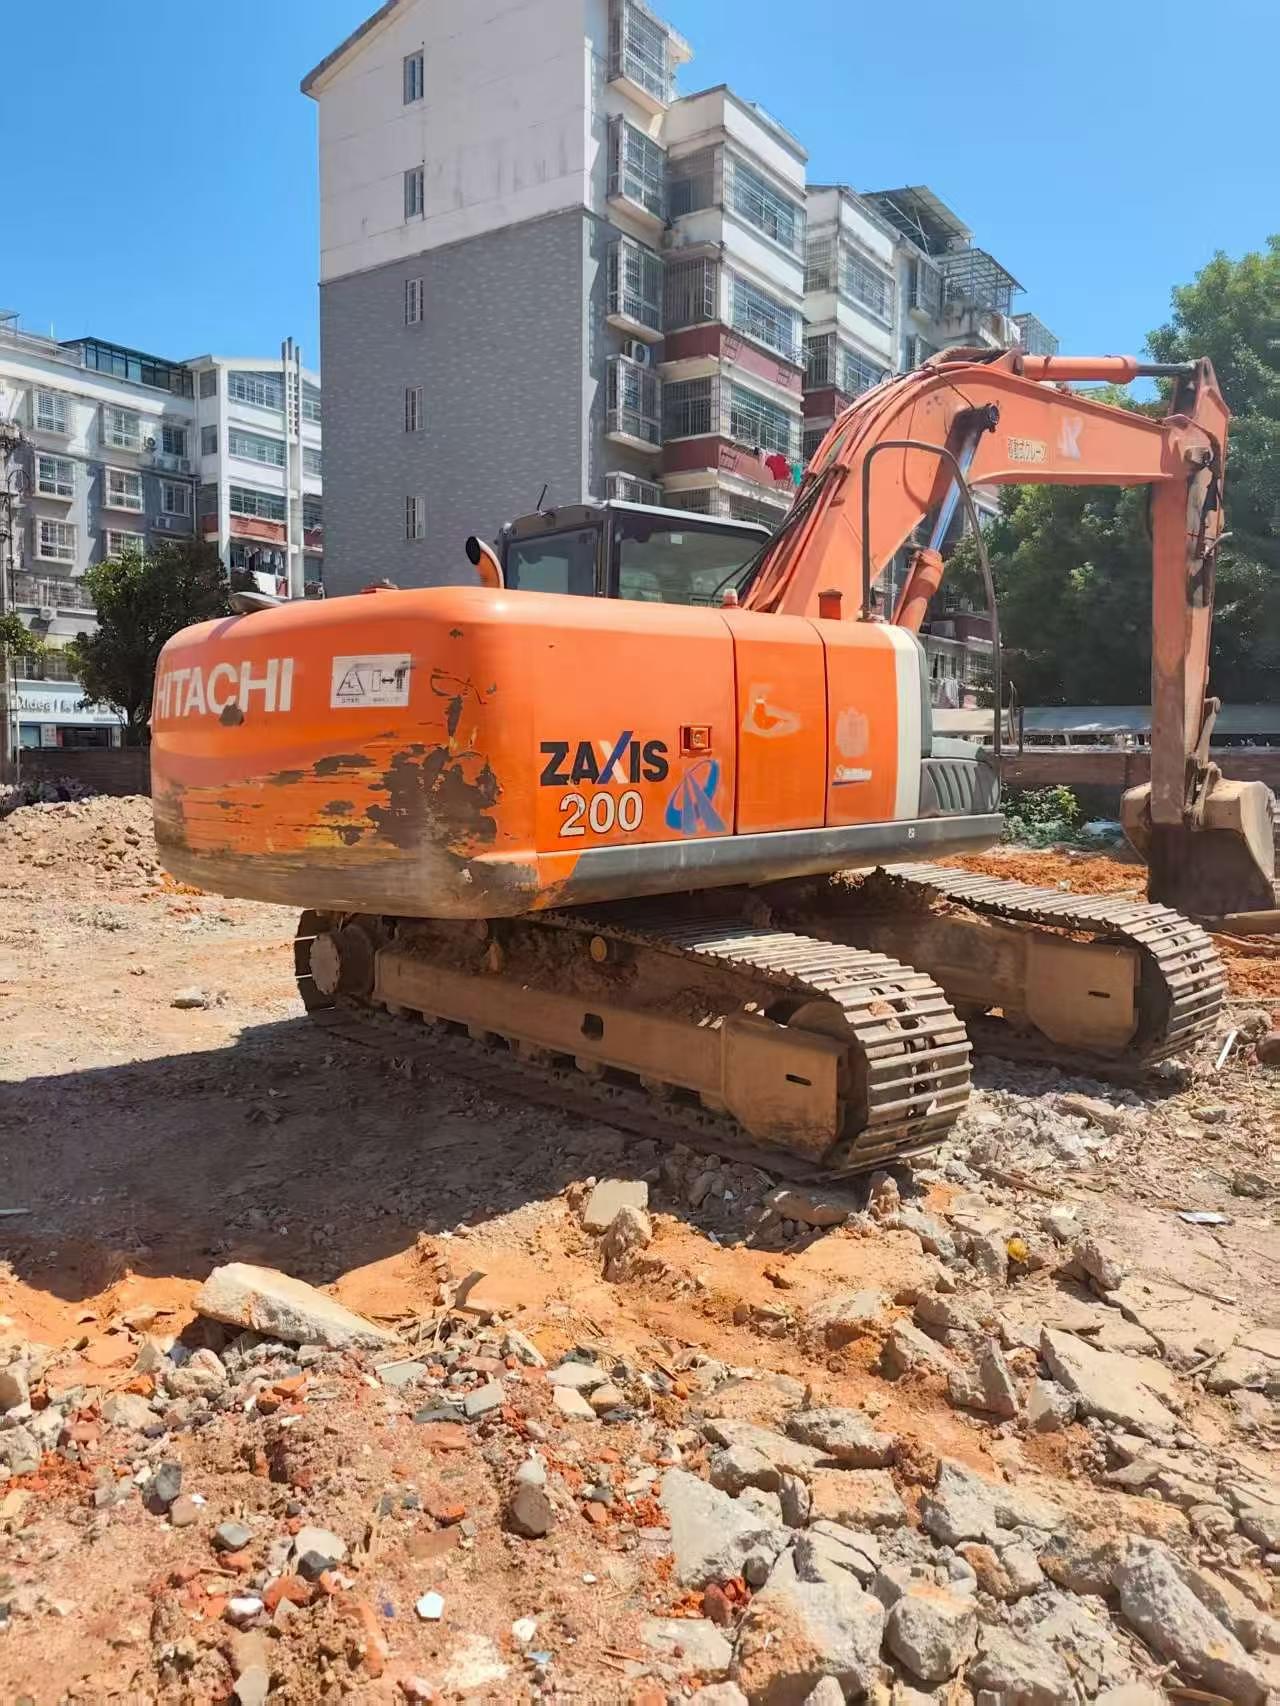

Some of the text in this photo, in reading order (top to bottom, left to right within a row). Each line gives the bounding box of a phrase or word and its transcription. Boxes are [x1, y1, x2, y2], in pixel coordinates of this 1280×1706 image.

[154, 658, 294, 721] HITACHI
[540, 731, 669, 786] ZAXIS
[559, 790, 643, 838] 200
